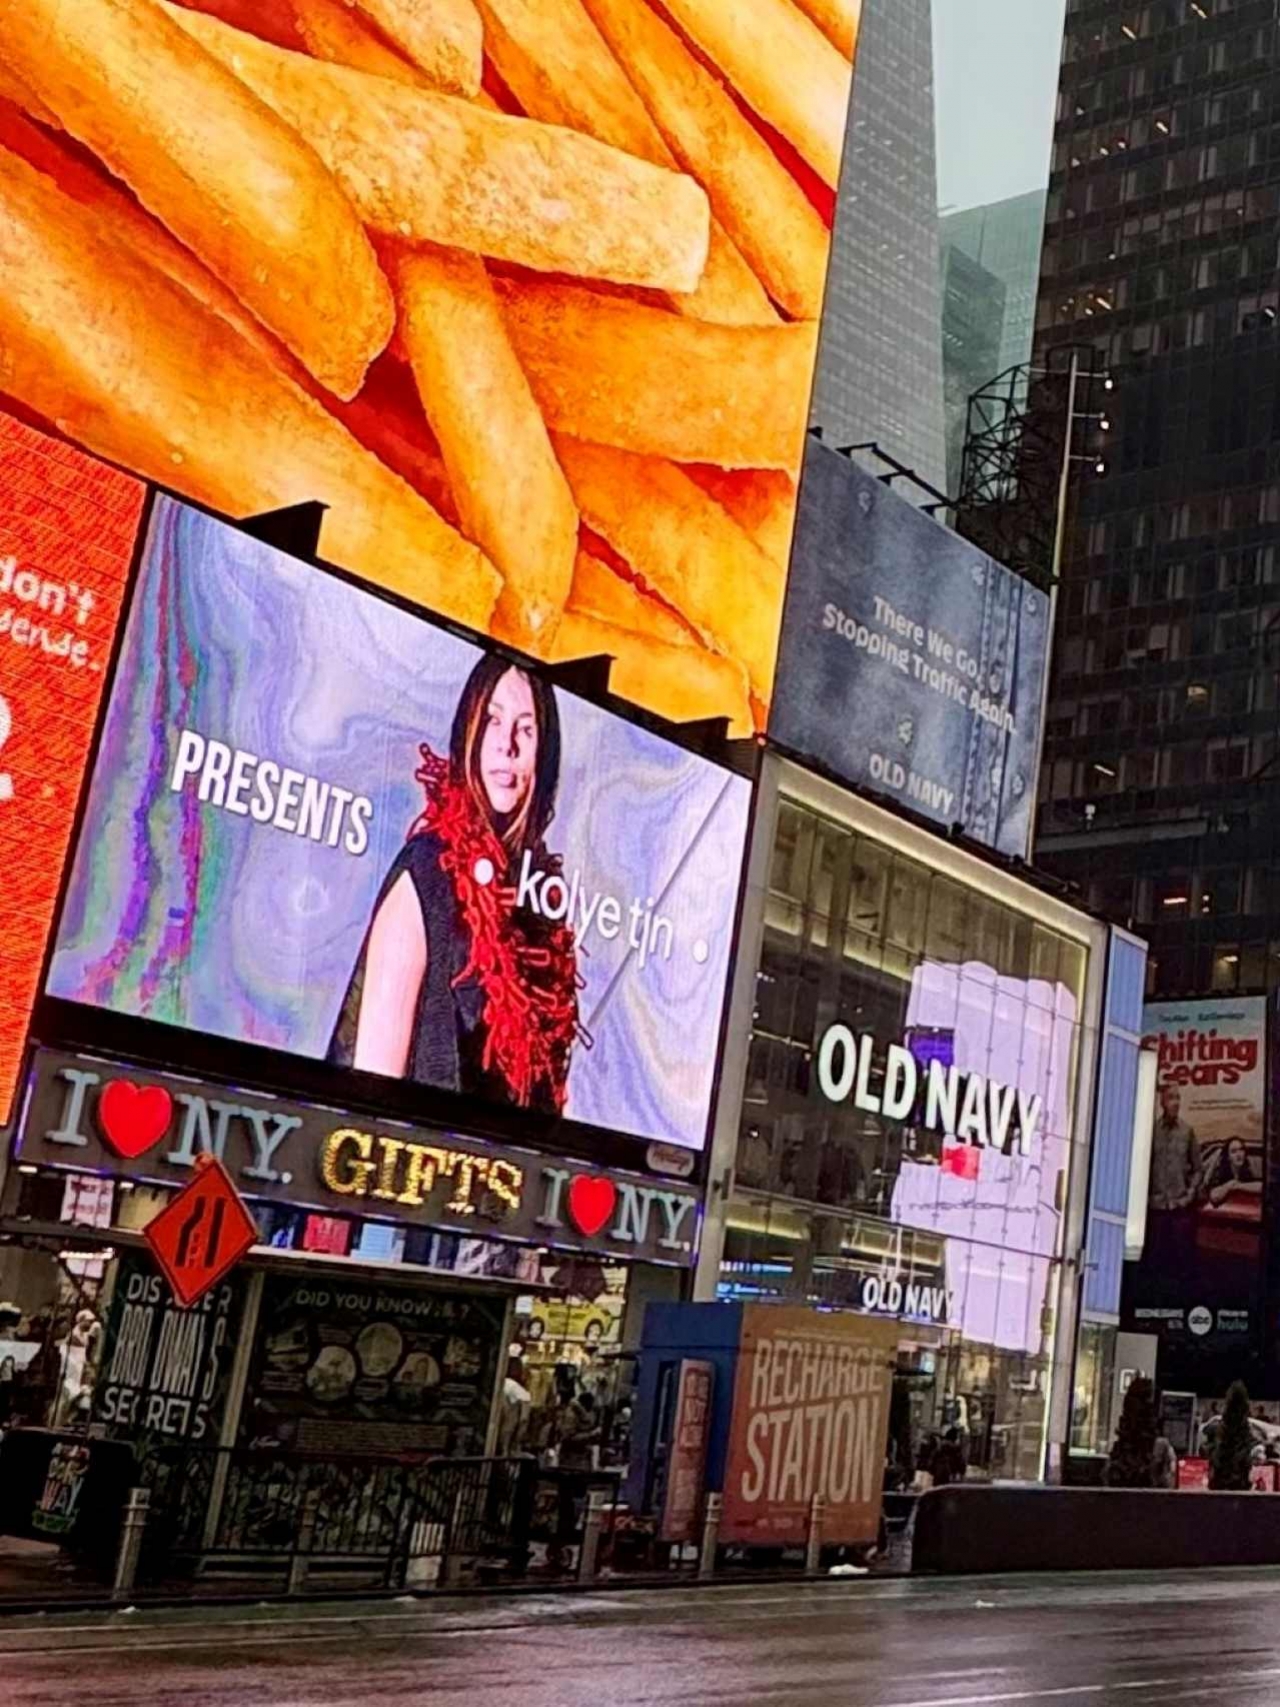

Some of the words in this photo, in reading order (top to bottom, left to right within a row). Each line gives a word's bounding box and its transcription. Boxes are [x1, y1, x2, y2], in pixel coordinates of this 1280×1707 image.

[823, 604, 912, 674] Stopping
[912, 654, 969, 707] Traffic
[874, 595, 924, 645] There
[927, 625, 954, 662] We
[170, 729, 374, 855] PRESENTS
[869, 755, 906, 792] OLD
[908, 774, 956, 815] NAVY
[517, 850, 622, 947] kolye
[818, 1024, 918, 1121] OLD
[925, 1059, 1042, 1156] NAVY
[45, 1068, 100, 1146] I
[322, 1128, 524, 1221] GIFTS
[535, 1167, 571, 1228] I
[126, 1273, 233, 1314] DISER
[294, 1288, 331, 1308] DID
[335, 1293, 373, 1312] YOU
[862, 1276, 902, 1312] OLD
[904, 1286, 954, 1320] NAVY
[750, 1339, 885, 1409] RECHARGE
[741, 1398, 882, 1503] STATION
